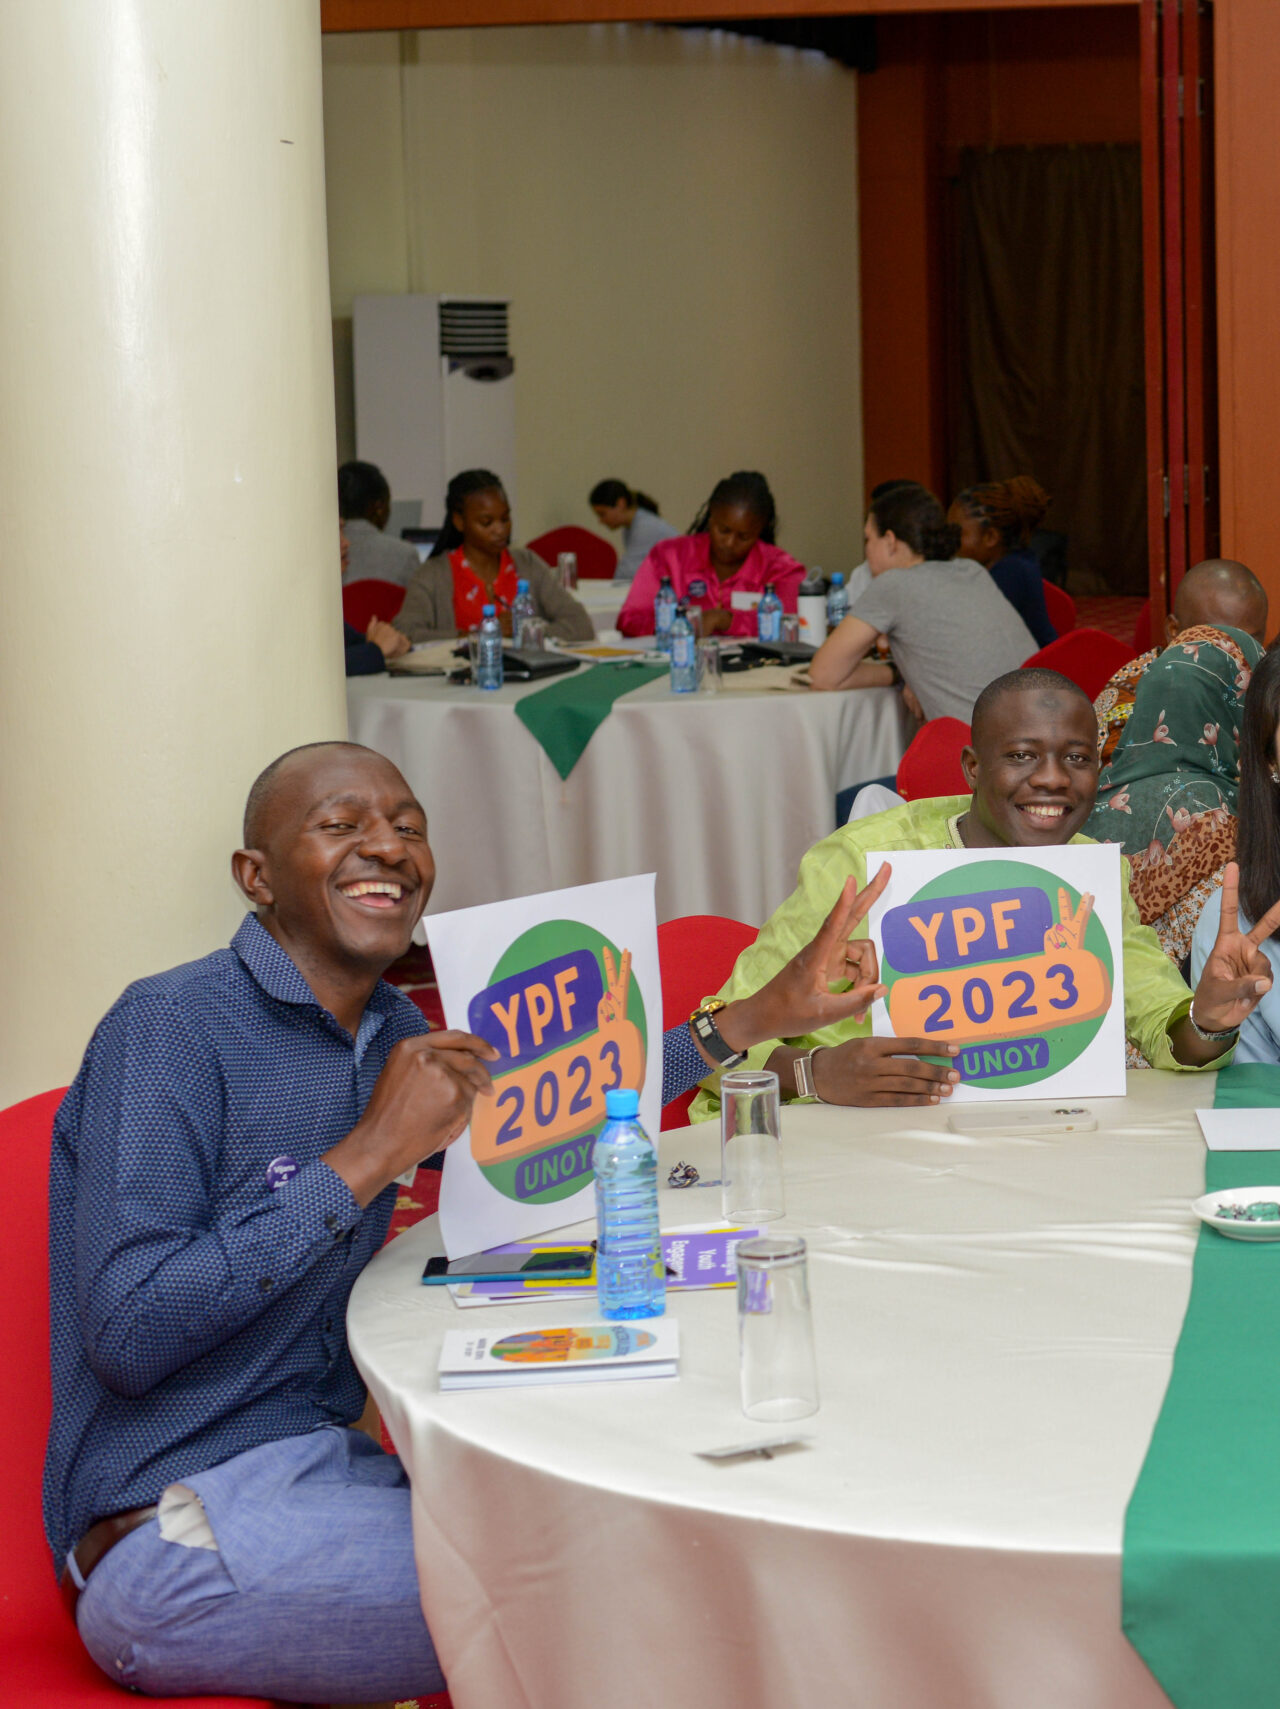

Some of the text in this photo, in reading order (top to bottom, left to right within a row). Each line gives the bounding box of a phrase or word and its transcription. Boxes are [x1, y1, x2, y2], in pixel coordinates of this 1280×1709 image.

[908, 899, 1021, 962] YPF
[490, 966, 580, 1058] YPF
[918, 963, 1079, 1033] 2023
[963, 1043, 1040, 1075] UNOY
[495, 1040, 623, 1146] 2023
[524, 1141, 592, 1191] UNOY
[697, 1248, 717, 1271] Youth
